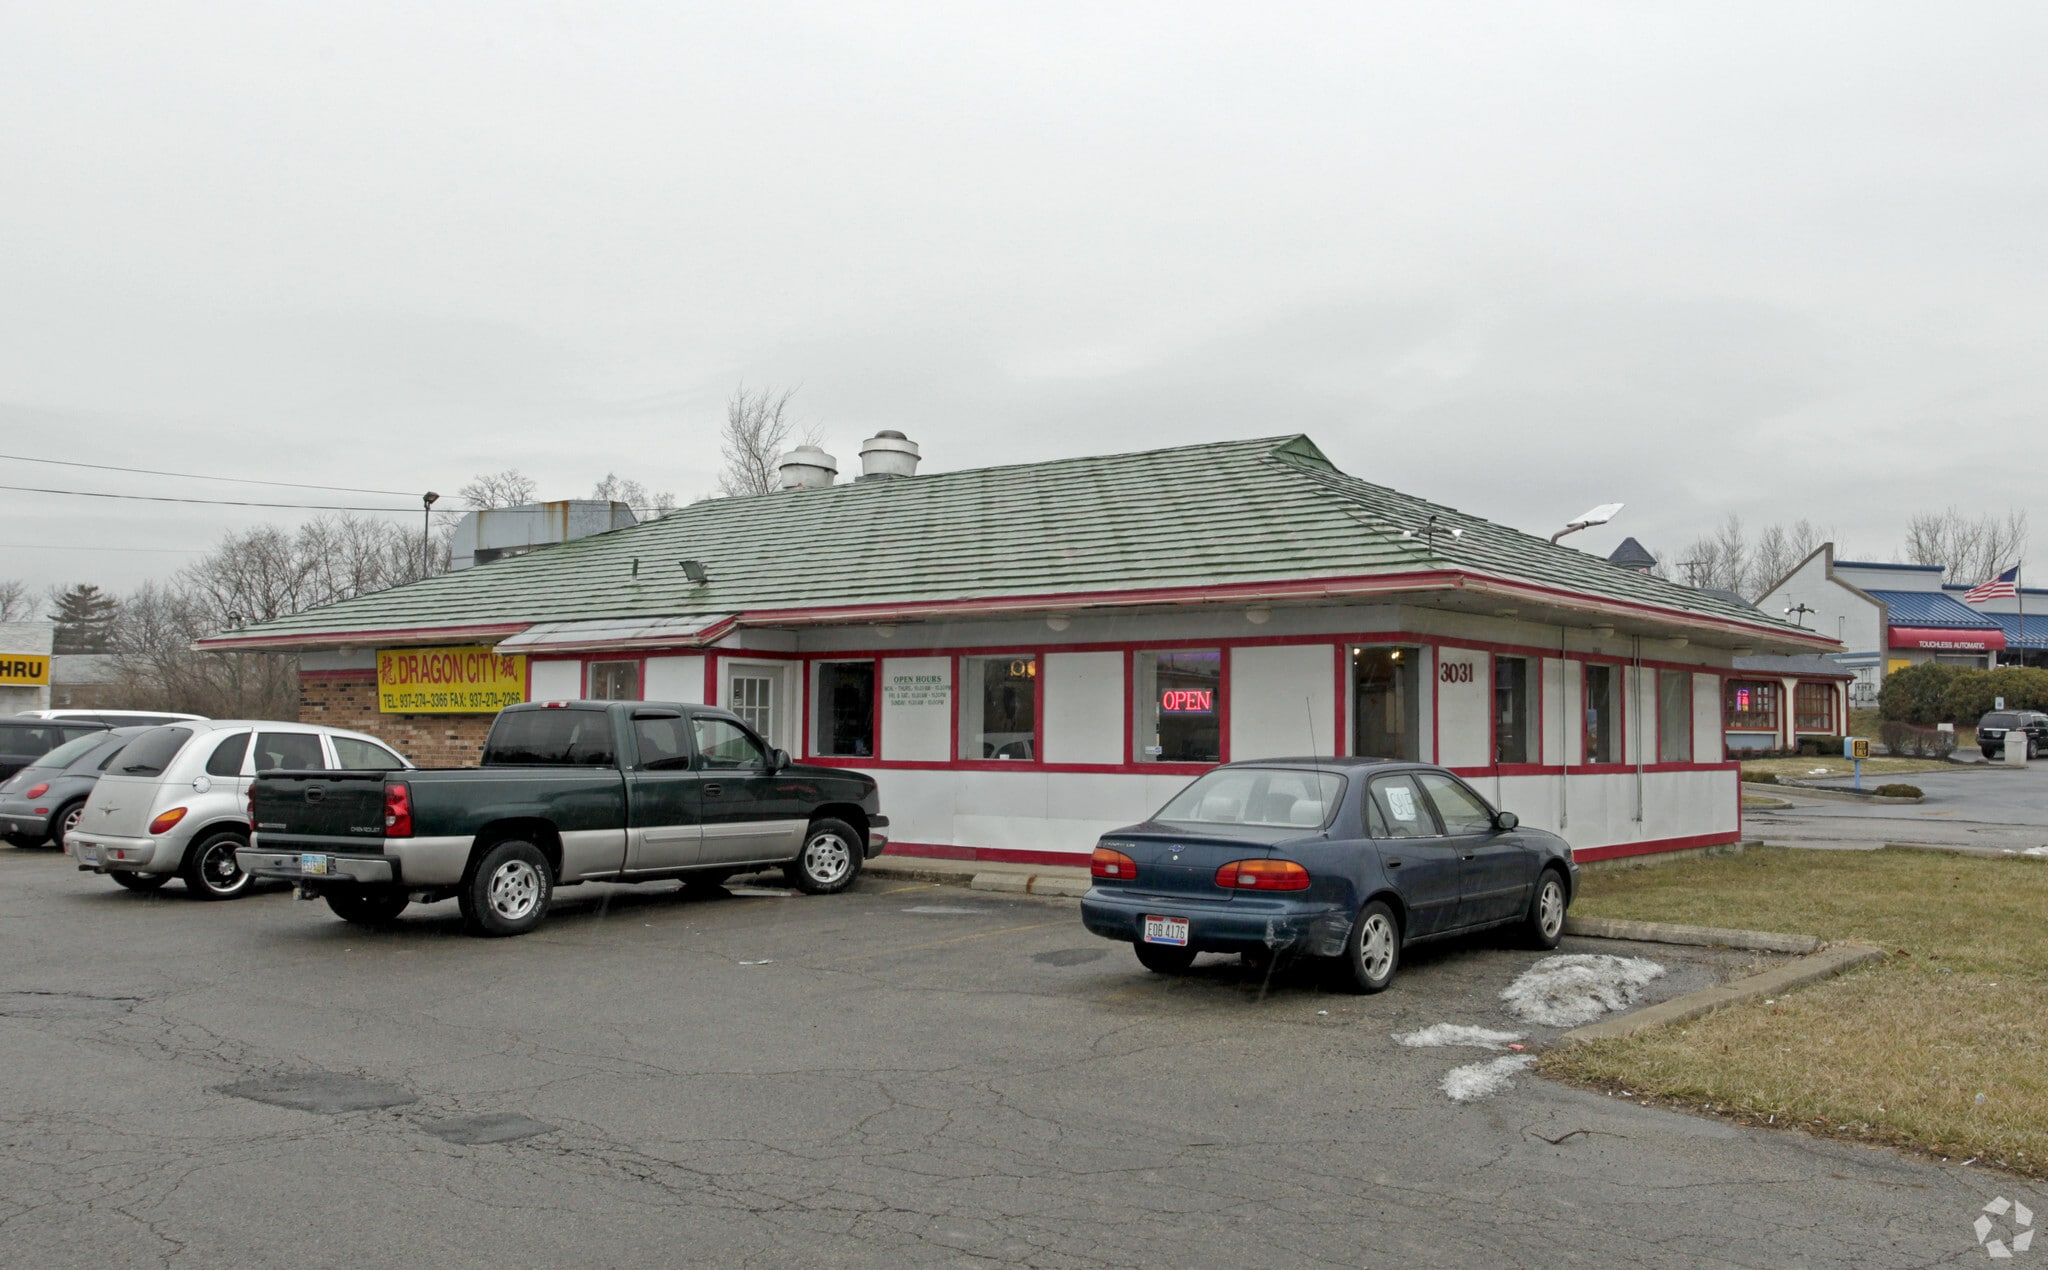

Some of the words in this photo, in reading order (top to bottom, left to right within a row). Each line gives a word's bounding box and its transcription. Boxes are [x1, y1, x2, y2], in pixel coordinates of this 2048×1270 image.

[1919, 640, 1952, 648] TOUCHLESS
[1954, 641, 1984, 649] AUTOMATIC
[398, 653, 463, 684] DRAGON
[466, 653, 498, 683] CITY
[1440, 662, 1474, 684] 3031
[915, 675, 942, 683] HOURS
[383, 694, 399, 709] TEL:
[399, 693, 448, 708] 937-274-3366
[449, 692, 467, 708] FAX:
[469, 691, 520, 708] 937-274-2266
[1163, 690, 1212, 711] OPEN
[1165, 924, 1185, 939] 4176
